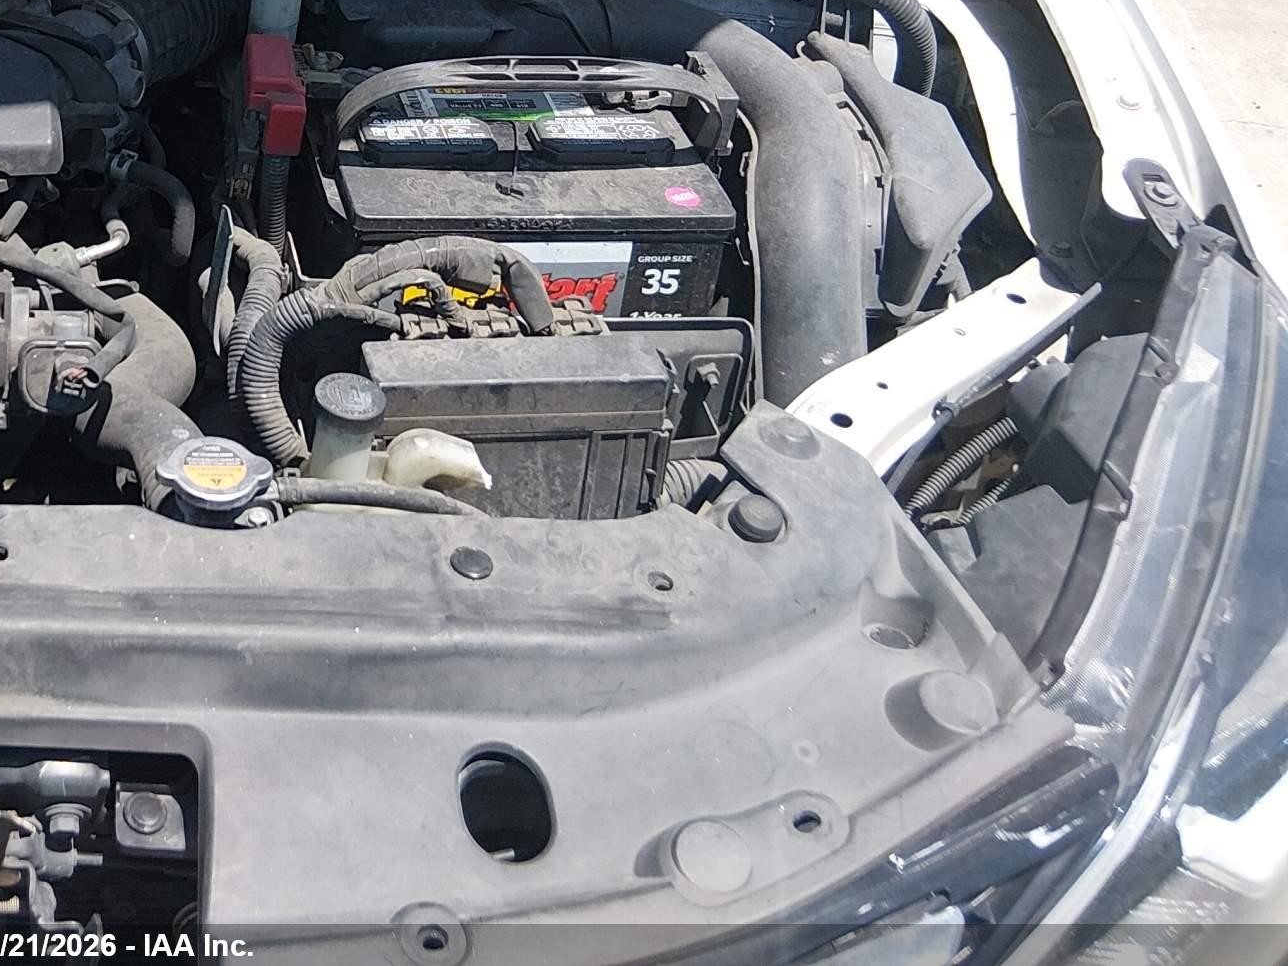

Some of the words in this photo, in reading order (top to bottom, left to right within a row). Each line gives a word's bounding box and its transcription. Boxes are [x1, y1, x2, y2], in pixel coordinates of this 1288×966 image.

[638, 255, 670, 263] GROUP
[672, 255, 693, 263] SIZE
[641, 269, 681, 295] 35
